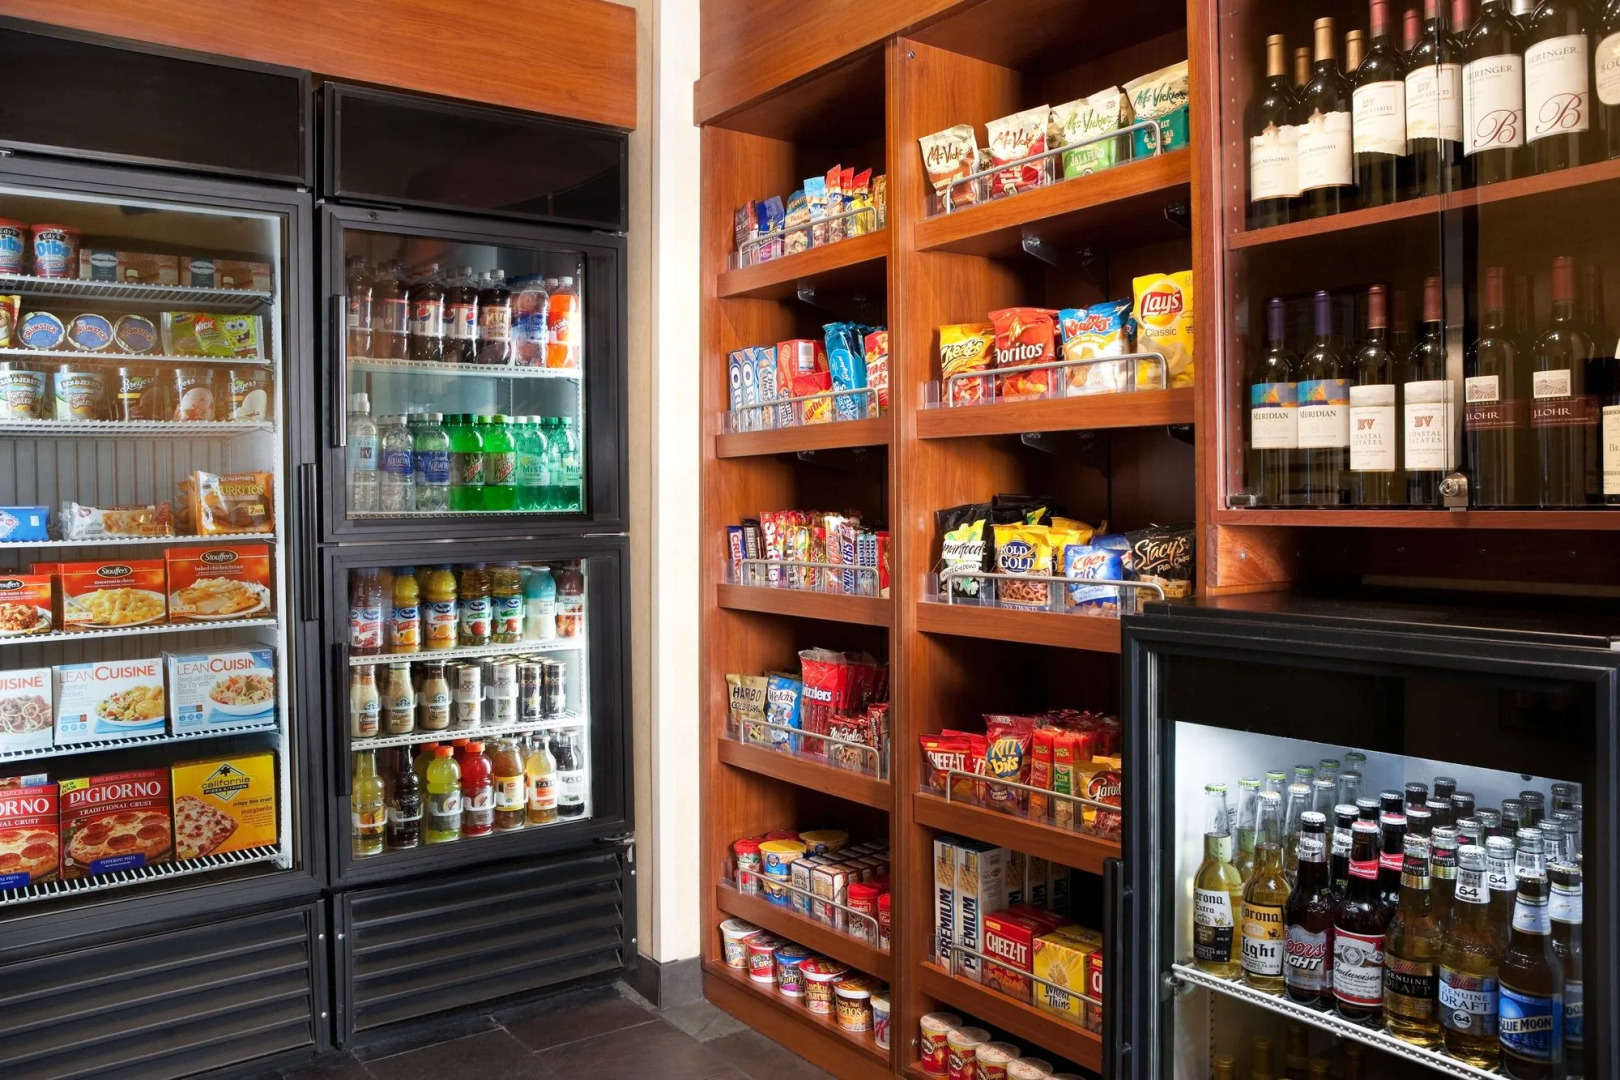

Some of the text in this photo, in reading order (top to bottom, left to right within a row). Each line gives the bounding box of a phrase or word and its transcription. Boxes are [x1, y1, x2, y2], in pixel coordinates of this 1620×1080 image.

[1528, 47, 1578, 64] BERINGER
[1467, 65, 1513, 79] BERINGER
[1535, 92, 1588, 134] B
[1474, 109, 1523, 148] B
[36, 240, 72, 257] Dibs
[1143, 289, 1181, 316] Lay's
[23, 323, 59, 340] DRUMSTICK
[195, 321, 213, 331] NICK
[1145, 326, 1177, 337] Classic
[1253, 412, 1289, 420] MERIDIAN
[1300, 410, 1337, 419] MERIDIAN
[1414, 415, 1433, 427] BV
[1357, 418, 1375, 430] BV
[205, 551, 235, 562] Stouffer's
[1001, 544, 1028, 555] ROLD
[999, 555, 1035, 569] GOLD
[101, 567, 129, 577] Stouffer's
[59, 664, 156, 684] LEAN CUISINE
[177, 658, 255, 676] LEAN CUISIN
[733, 686, 762, 702] HARIBO
[769, 690, 794, 703] Welch's
[991, 738, 1017, 758] RITZ
[990, 756, 1019, 774] bits
[201, 776, 251, 790] california
[79, 800, 153, 816] TRADITIONAL CRUST
[1489, 875, 1508, 885] 64
[1194, 891, 1223, 905] orona
[1458, 886, 1479, 897] 64
[939, 887, 952, 960] PREMIUM
[985, 931, 1028, 965] CHEEZ-IT
[1242, 934, 1275, 959] Light
[1386, 969, 1429, 986] GENUINE
[1442, 987, 1489, 1001] GENUINE
[1441, 993, 1490, 1012] DRAFT
[1454, 1013, 1471, 1024] 64
[1520, 1017, 1552, 1030] MOON
